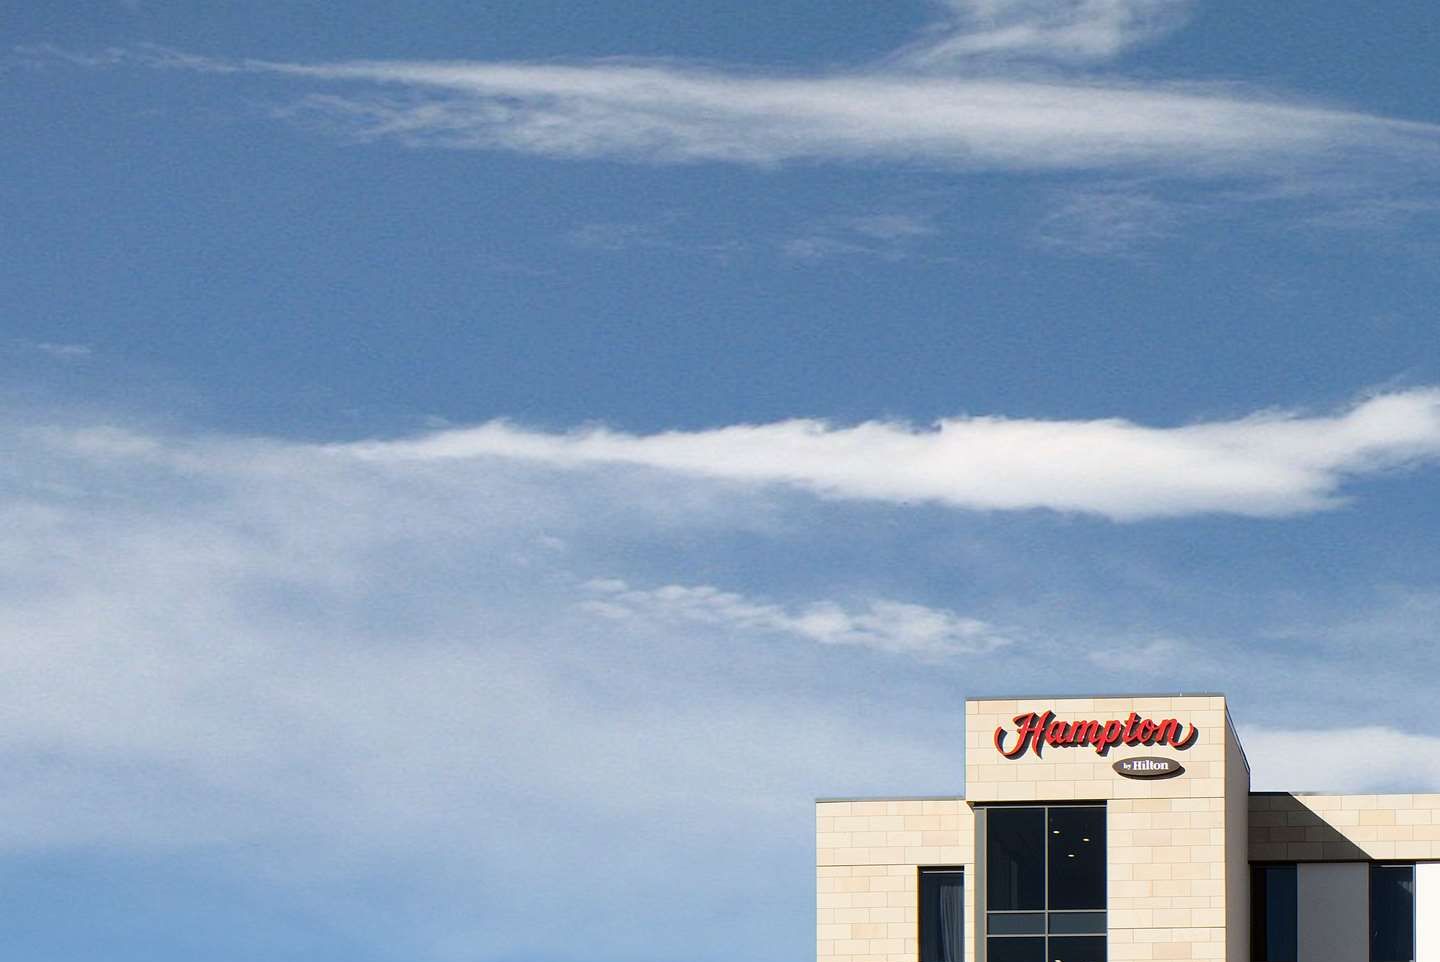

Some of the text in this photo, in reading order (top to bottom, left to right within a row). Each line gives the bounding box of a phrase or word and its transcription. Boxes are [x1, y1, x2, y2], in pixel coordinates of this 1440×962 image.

[994, 710, 1198, 759] Hampton
[1123, 760, 1169, 770] by Hilton
